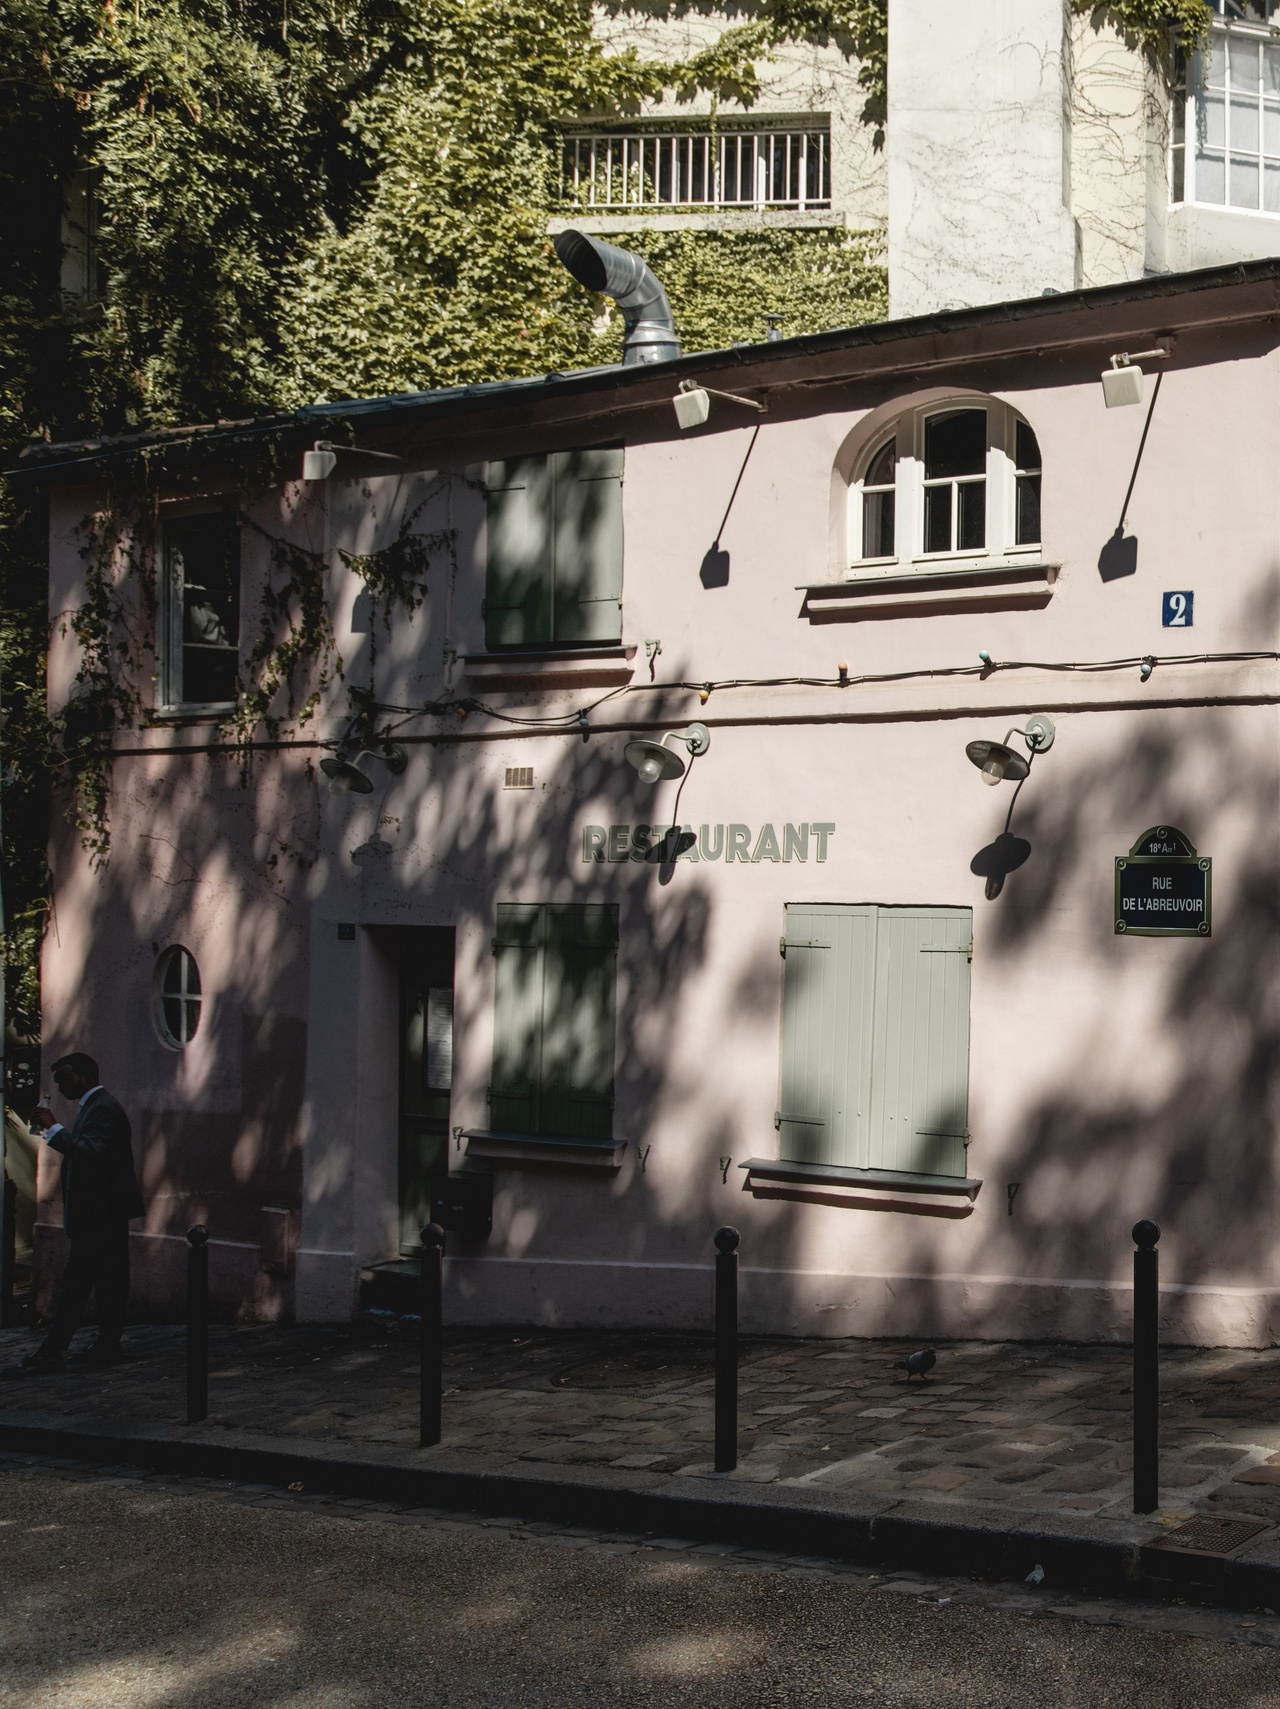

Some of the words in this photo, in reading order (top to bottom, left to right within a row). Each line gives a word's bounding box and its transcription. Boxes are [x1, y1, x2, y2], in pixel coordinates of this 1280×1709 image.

[1168, 593, 1187, 626] 2
[582, 822, 836, 863] RESTAURANT
[1152, 877, 1173, 890] RUE
[1122, 898, 1136, 911] DE
[1138, 898, 1203, 911] L'ABREUVOIR
